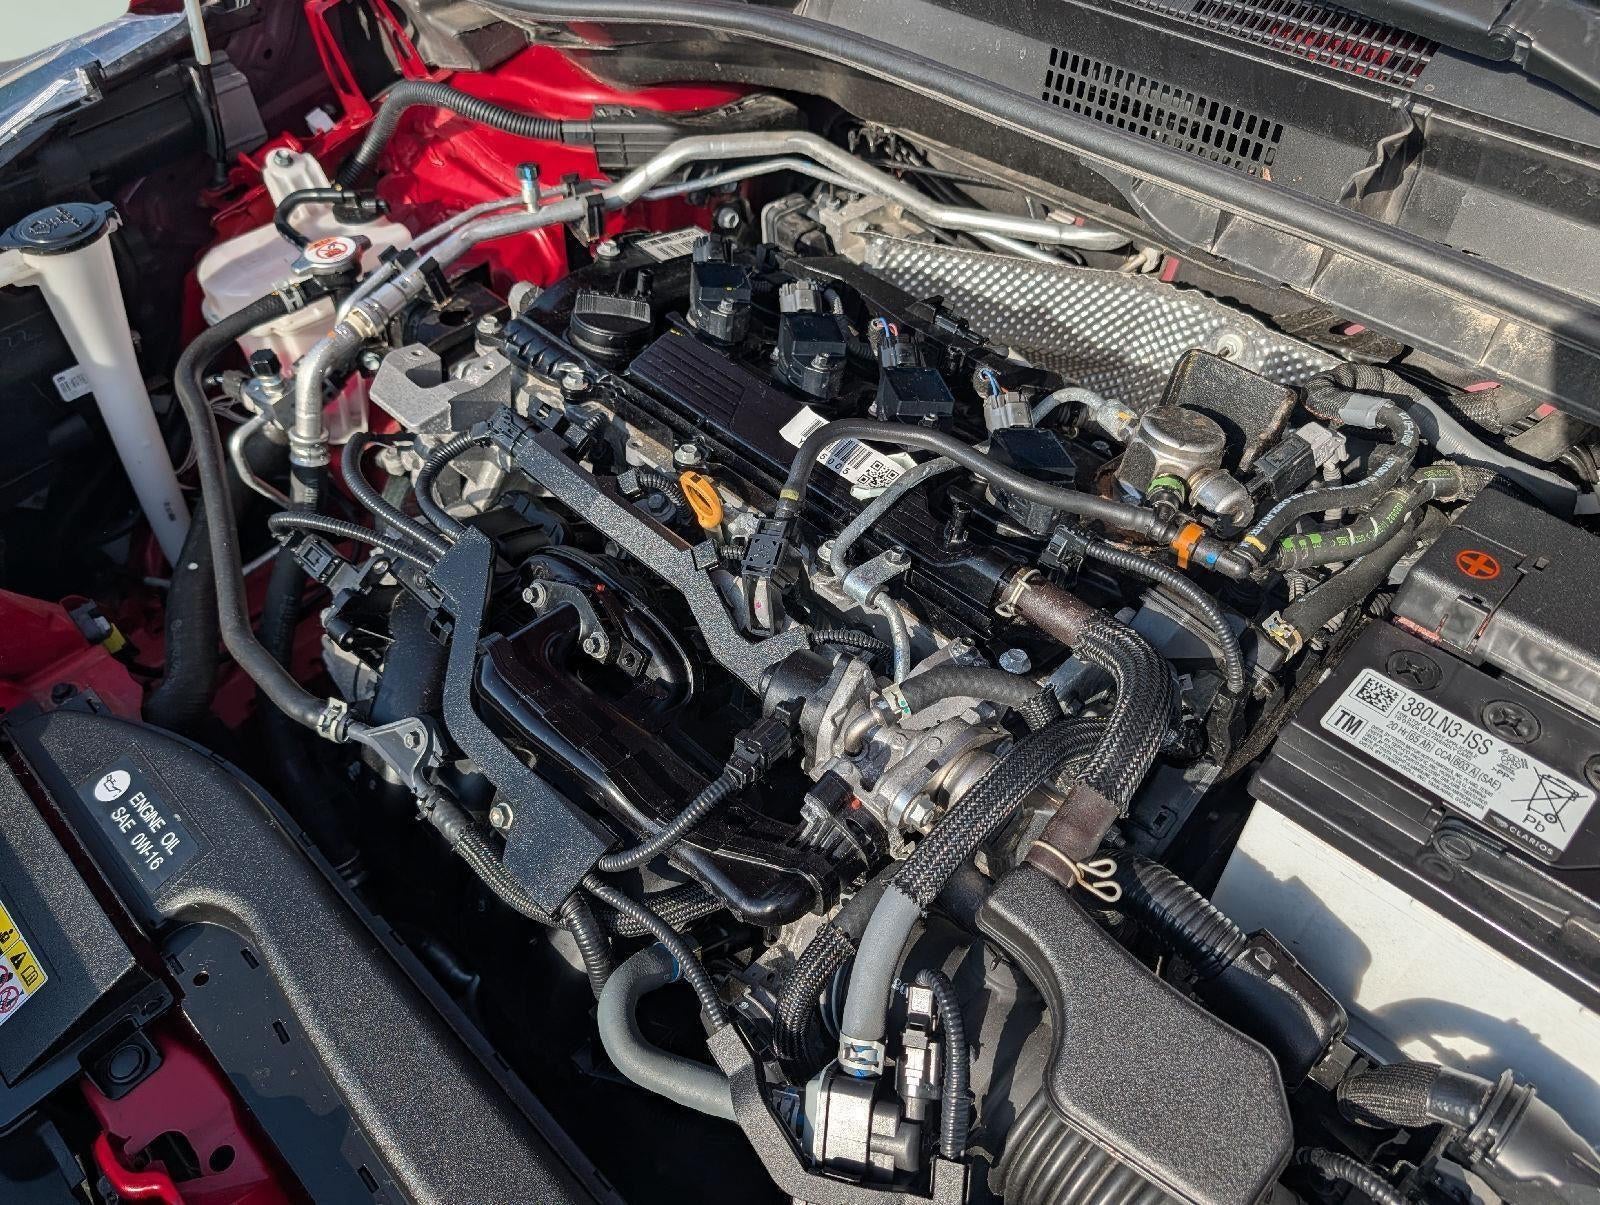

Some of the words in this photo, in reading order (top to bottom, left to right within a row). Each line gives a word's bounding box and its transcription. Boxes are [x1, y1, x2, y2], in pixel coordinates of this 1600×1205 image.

[1334, 709, 1363, 735] TM
[1401, 696, 1493, 754] 380LN3-ISS
[1385, 720, 1398, 730] 20
[1397, 726, 1409, 736] Hr
[1408, 732, 1420, 743] 65
[1419, 739, 1432, 750] Ah
[1434, 747, 1453, 762] CCA
[1476, 772, 1501, 790] (SAE)
[111, 806, 136, 833] SAE
[130, 832, 163, 870] 0W-16
[129, 791, 166, 833] ENGINE
[160, 831, 180, 855] OIL
[1509, 826, 1553, 854] CLARIOS
[1522, 813, 1545, 832] Pb
